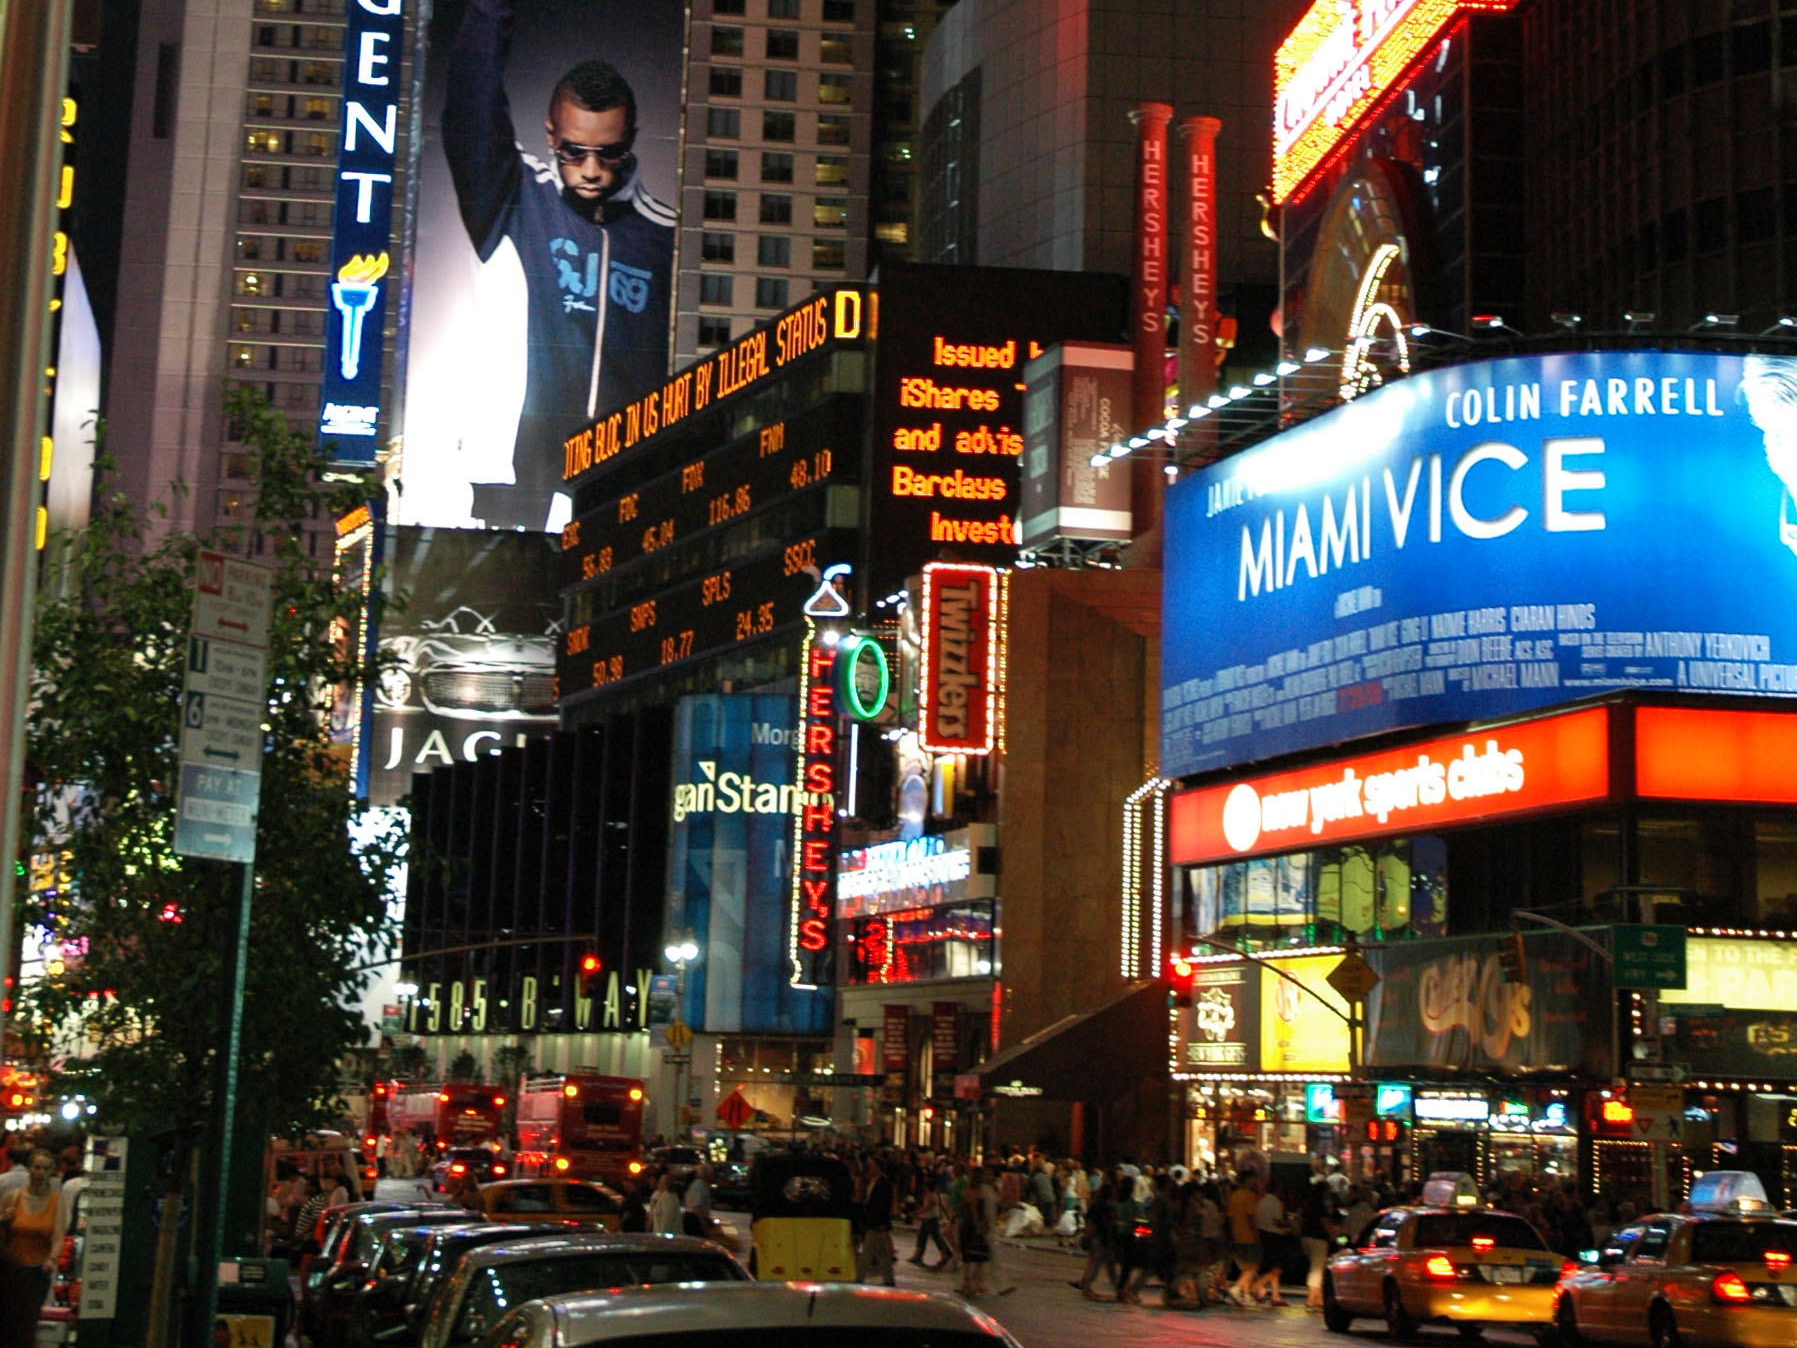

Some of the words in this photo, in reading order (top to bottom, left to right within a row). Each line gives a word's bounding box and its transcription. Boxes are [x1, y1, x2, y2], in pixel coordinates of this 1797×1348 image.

[934, 336, 1016, 369] Issued
[595, 412, 622, 465] BLOC
[624, 402, 641, 449] IN
[643, 391, 660, 438] US
[662, 372, 693, 429] HURT
[695, 360, 713, 411] BY
[717, 330, 770, 400] ILLEGAL
[776, 296, 827, 367] STATUS
[901, 378, 1000, 412] iShares
[1446, 383, 1541, 429] COLIN
[1561, 377, 1725, 417] FARRELL
[893, 422, 942, 452] and
[892, 465, 1007, 501] Barclays
[1383, 436, 1607, 550] VICE
[931, 510, 1019, 544] Invest
[1237, 473, 1371, 602] MIAMI
[935, 580, 980, 739] Twizzlers
[384, 726, 527, 771] JAG
[751, 722, 803, 751] Morg
[1261, 787, 1309, 833] new
[1309, 768, 1364, 834] york
[1363, 754, 1446, 823] sports
[1447, 739, 1524, 801] clubs
[1713, 945, 1740, 963] TO
[1744, 946, 1784, 965] THE
